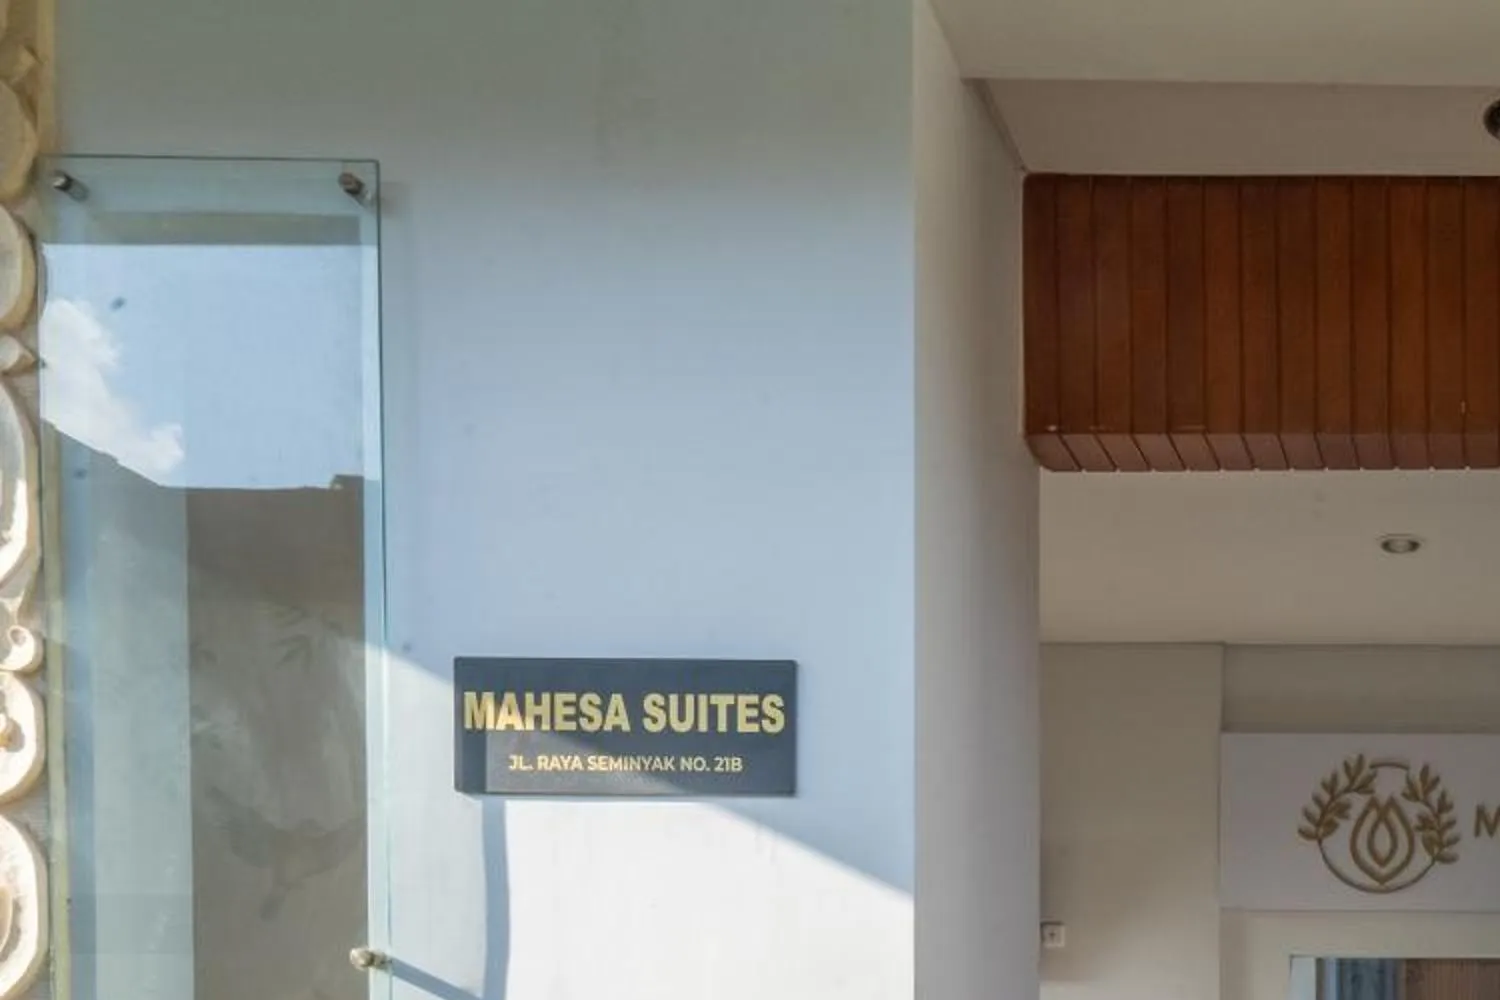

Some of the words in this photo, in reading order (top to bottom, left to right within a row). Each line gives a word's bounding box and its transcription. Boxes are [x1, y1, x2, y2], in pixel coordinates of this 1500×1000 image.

[463, 691, 631, 732] MAHESA
[642, 693, 786, 733] SUITES
[508, 755, 533, 771] JL.
[537, 755, 584, 772] RAYA
[587, 756, 676, 772] SEMINYAK
[680, 757, 710, 772] NO.
[714, 757, 744, 772] 21B
